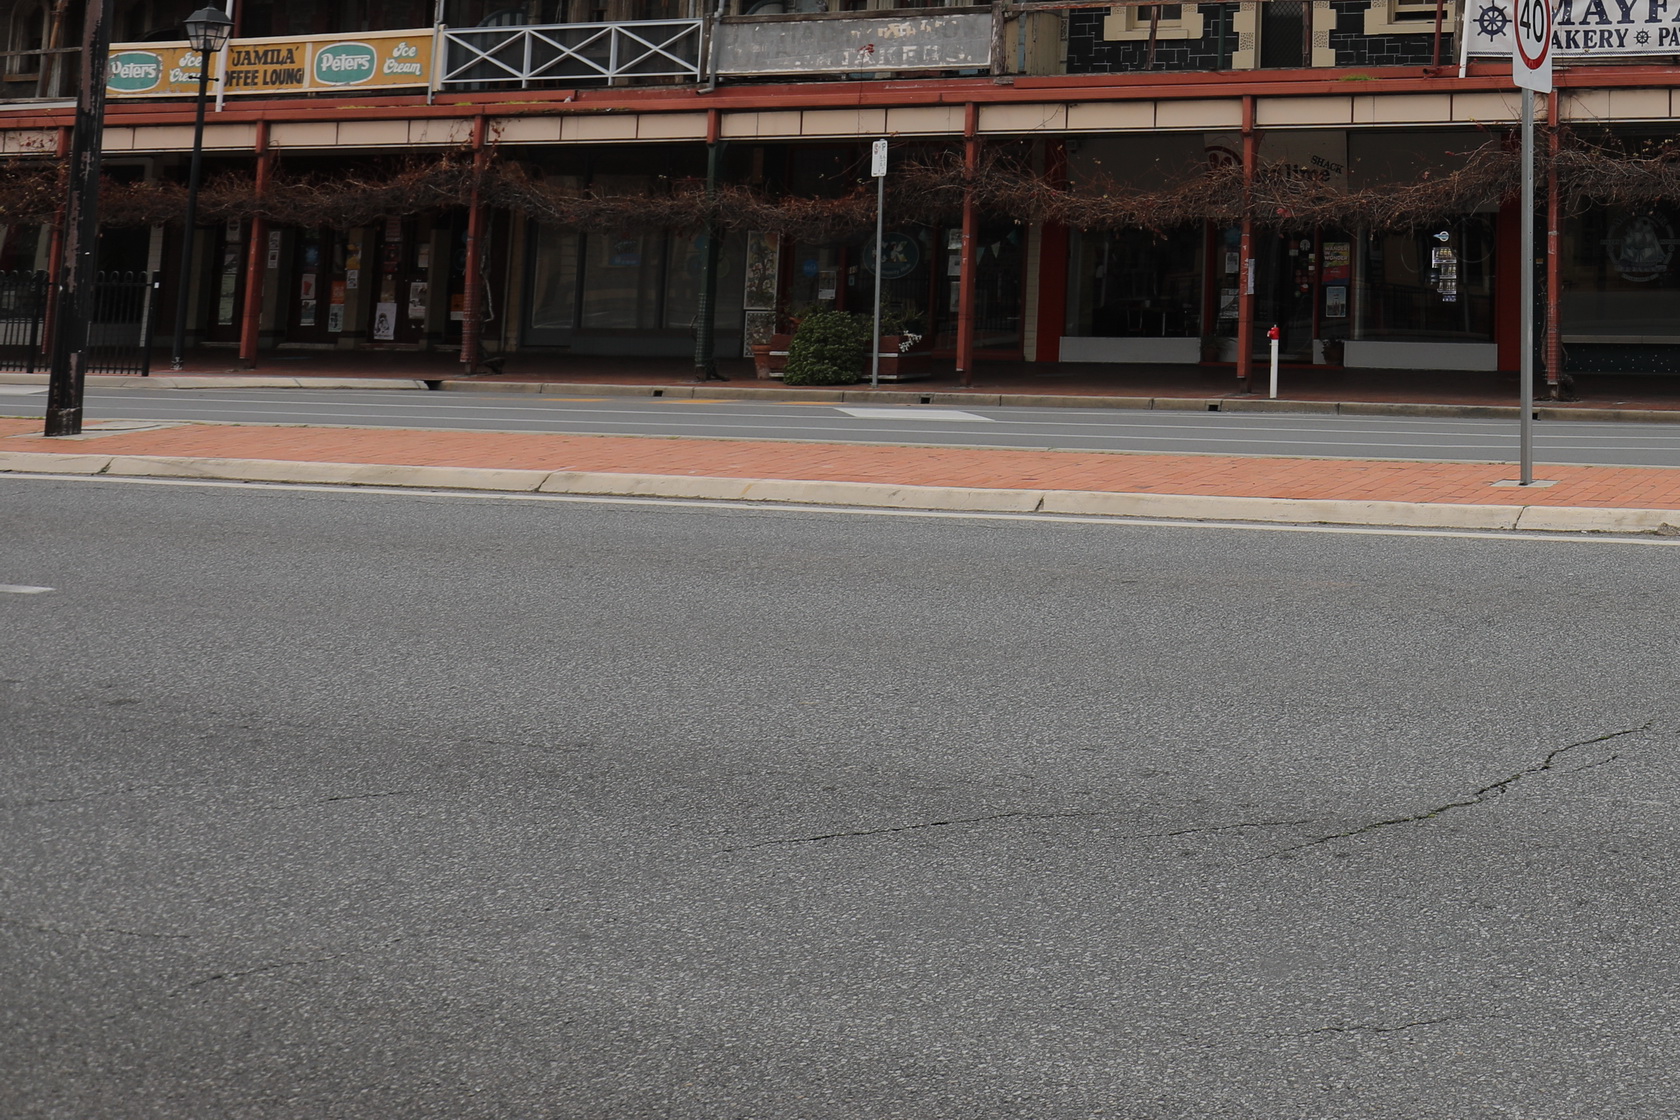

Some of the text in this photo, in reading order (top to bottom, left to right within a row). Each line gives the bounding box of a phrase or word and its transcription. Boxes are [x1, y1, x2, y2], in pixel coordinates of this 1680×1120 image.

[1552, 28, 1628, 49] AKERY
[179, 52, 202, 67] Ice
[393, 42, 416, 60] Ice
[321, 53, 371, 72] Peters
[384, 58, 422, 76] Cream
[224, 68, 304, 87] OFFEE LOUNG
[1311, 155, 1345, 174] SHACK
